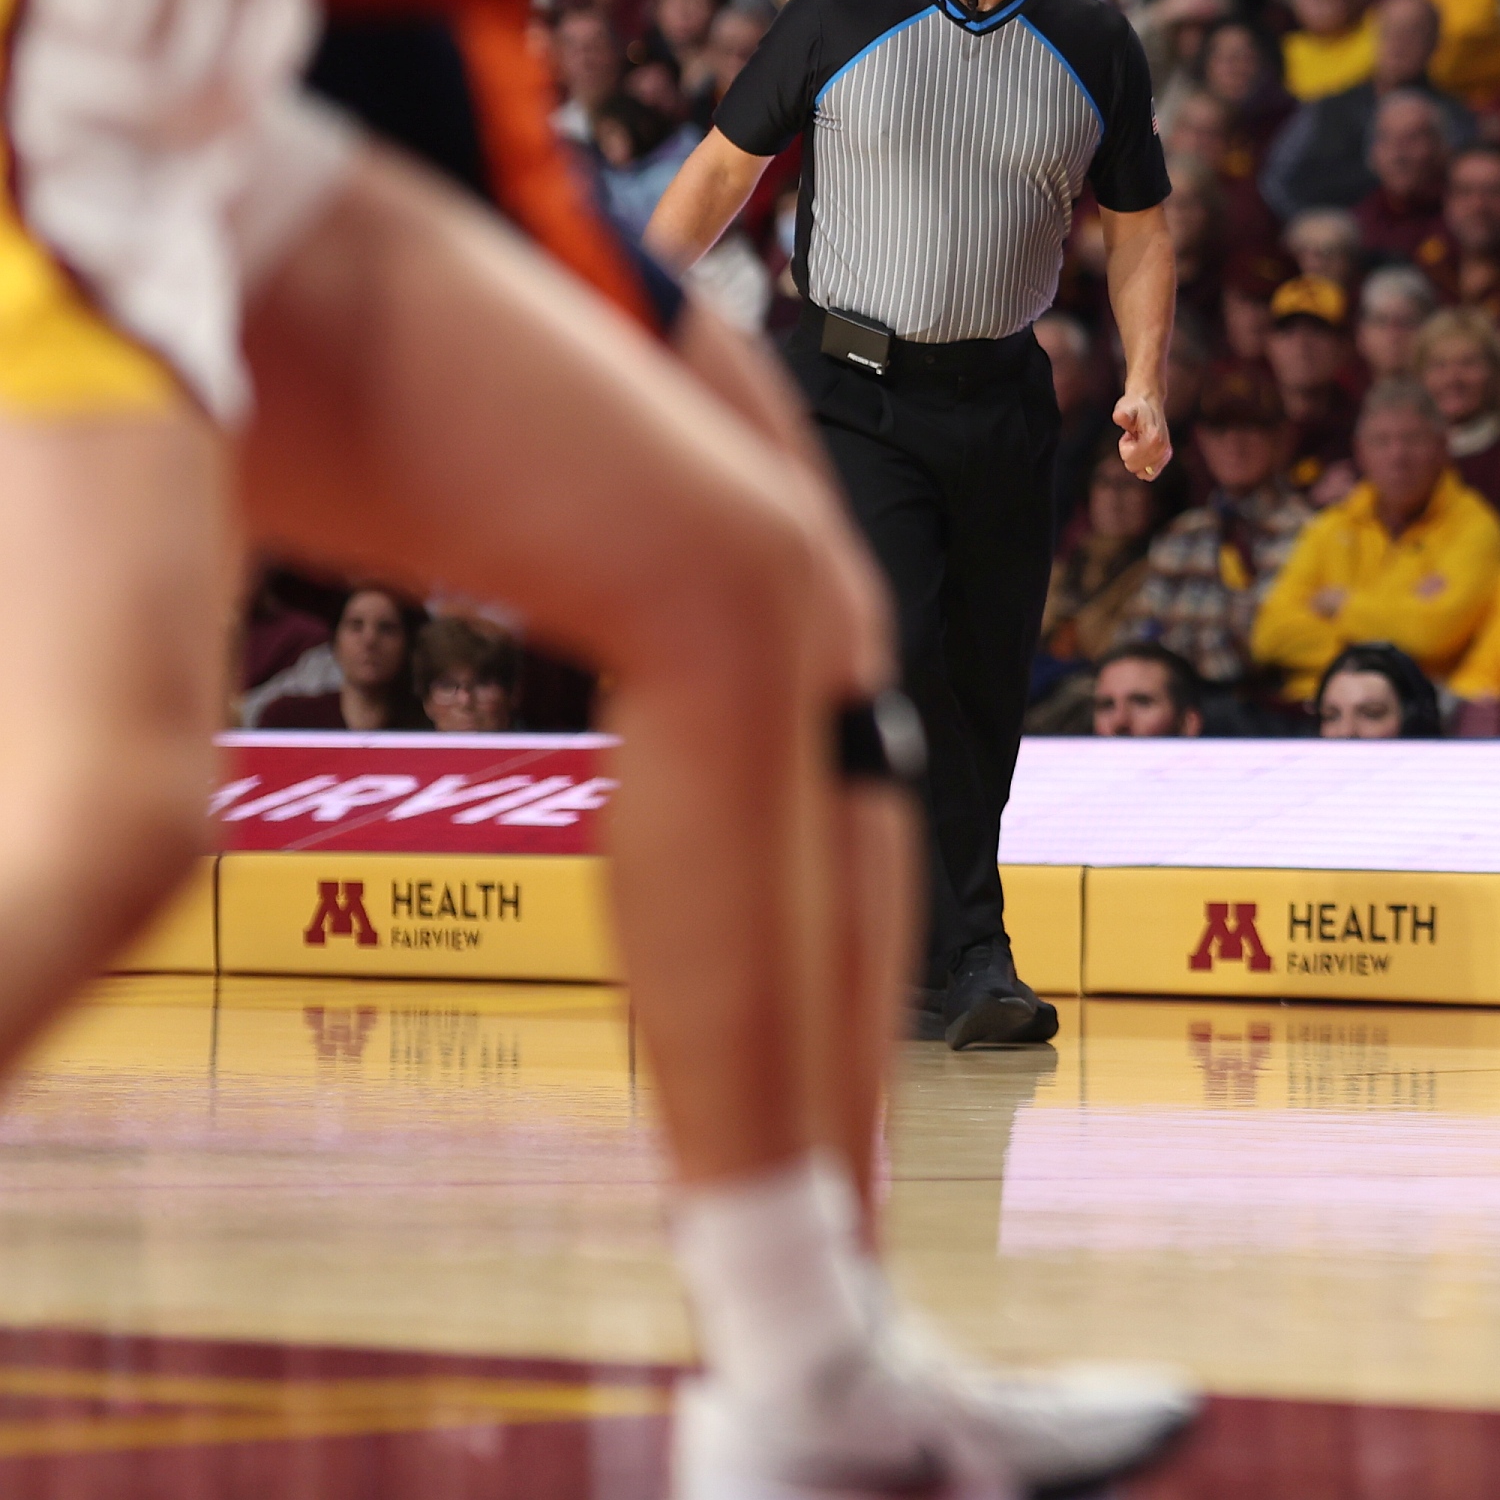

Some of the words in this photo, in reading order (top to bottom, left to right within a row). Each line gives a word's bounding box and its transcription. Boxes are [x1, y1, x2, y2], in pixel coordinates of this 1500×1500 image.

[391, 879, 520, 920] HEALTH
[390, 928, 481, 950] FAIRVIEW
[1288, 902, 1436, 944] HEALTH
[1286, 952, 1391, 976] FAIRVIEW
